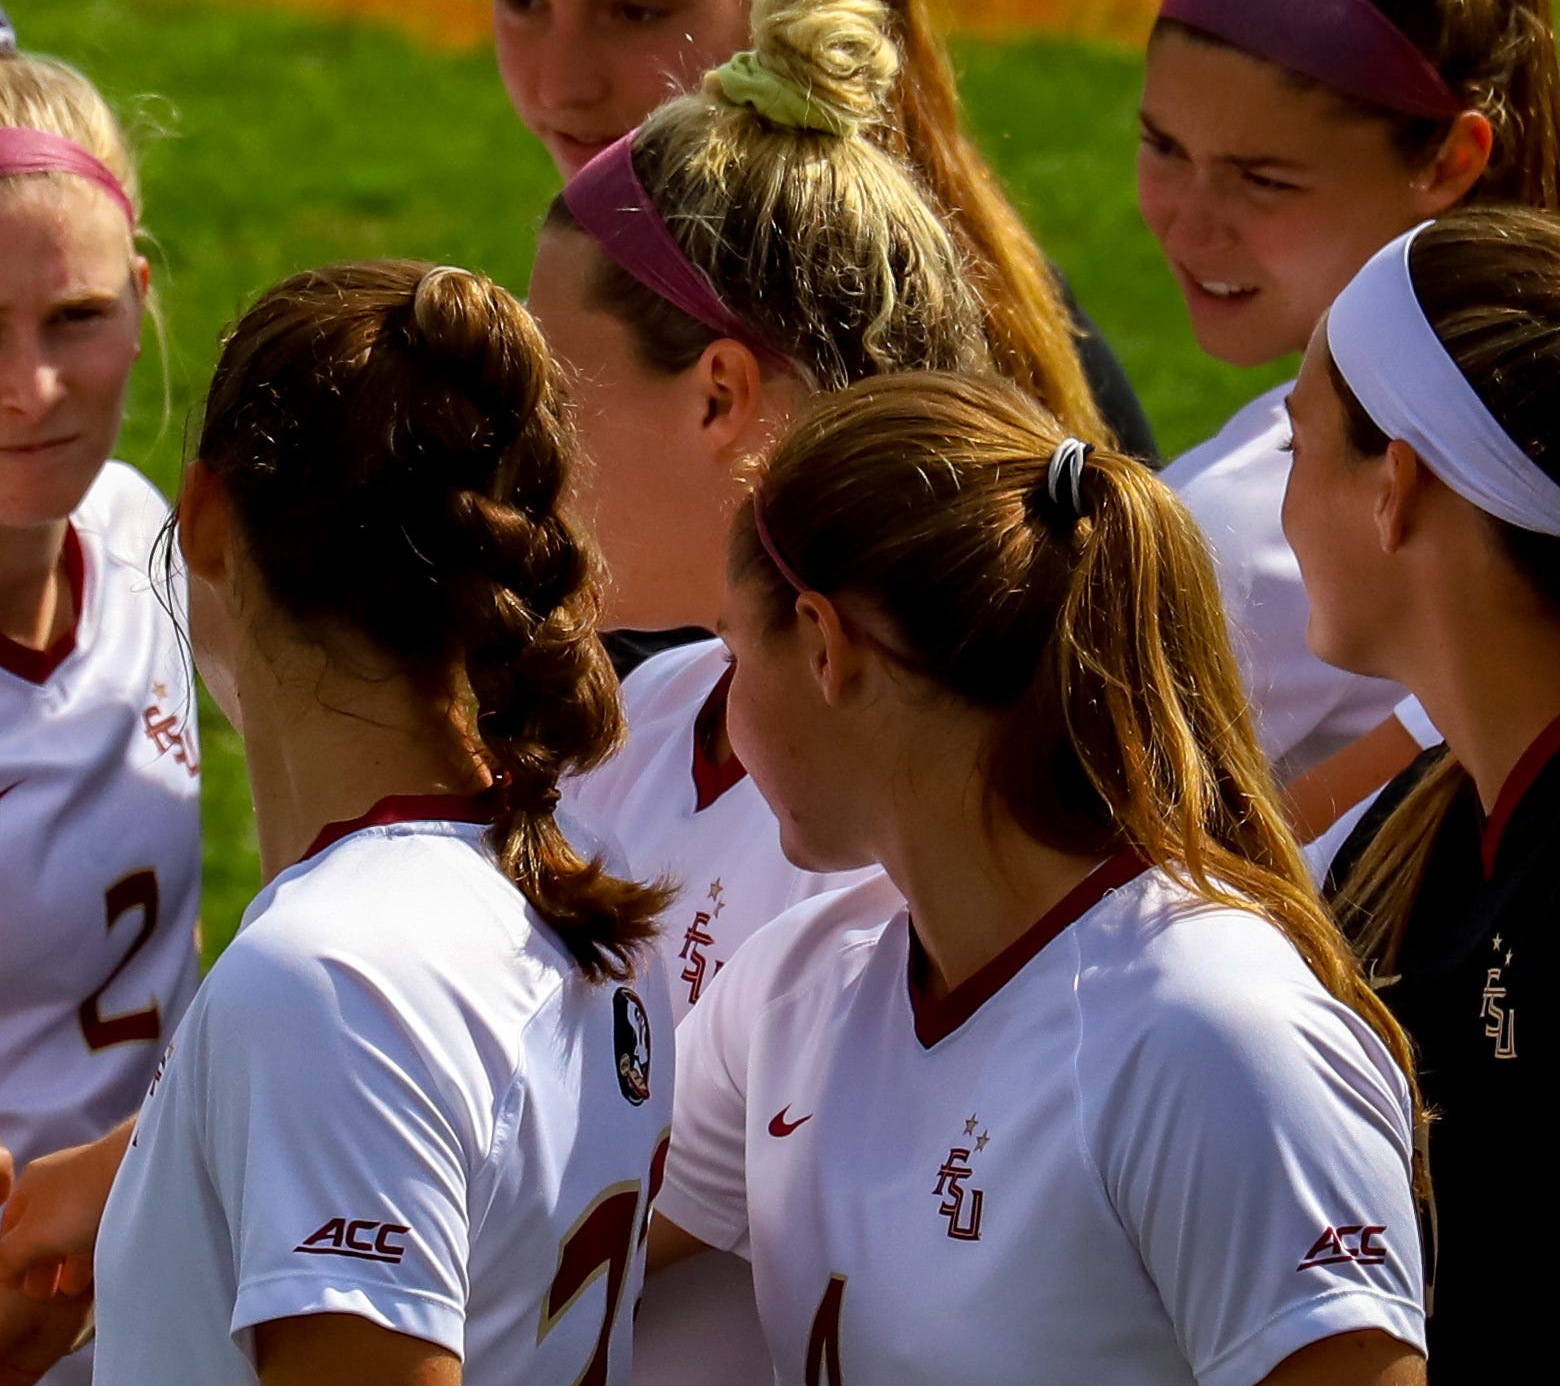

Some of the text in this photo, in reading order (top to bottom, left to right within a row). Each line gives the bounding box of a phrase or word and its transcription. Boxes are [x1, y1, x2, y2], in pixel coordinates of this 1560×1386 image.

[79, 865, 161, 1055] 2
[1480, 967, 1518, 1059] FSU
[298, 1217, 411, 1259] ACC
[932, 1147, 984, 1241] FSU
[1300, 1225, 1387, 1265] ACC
